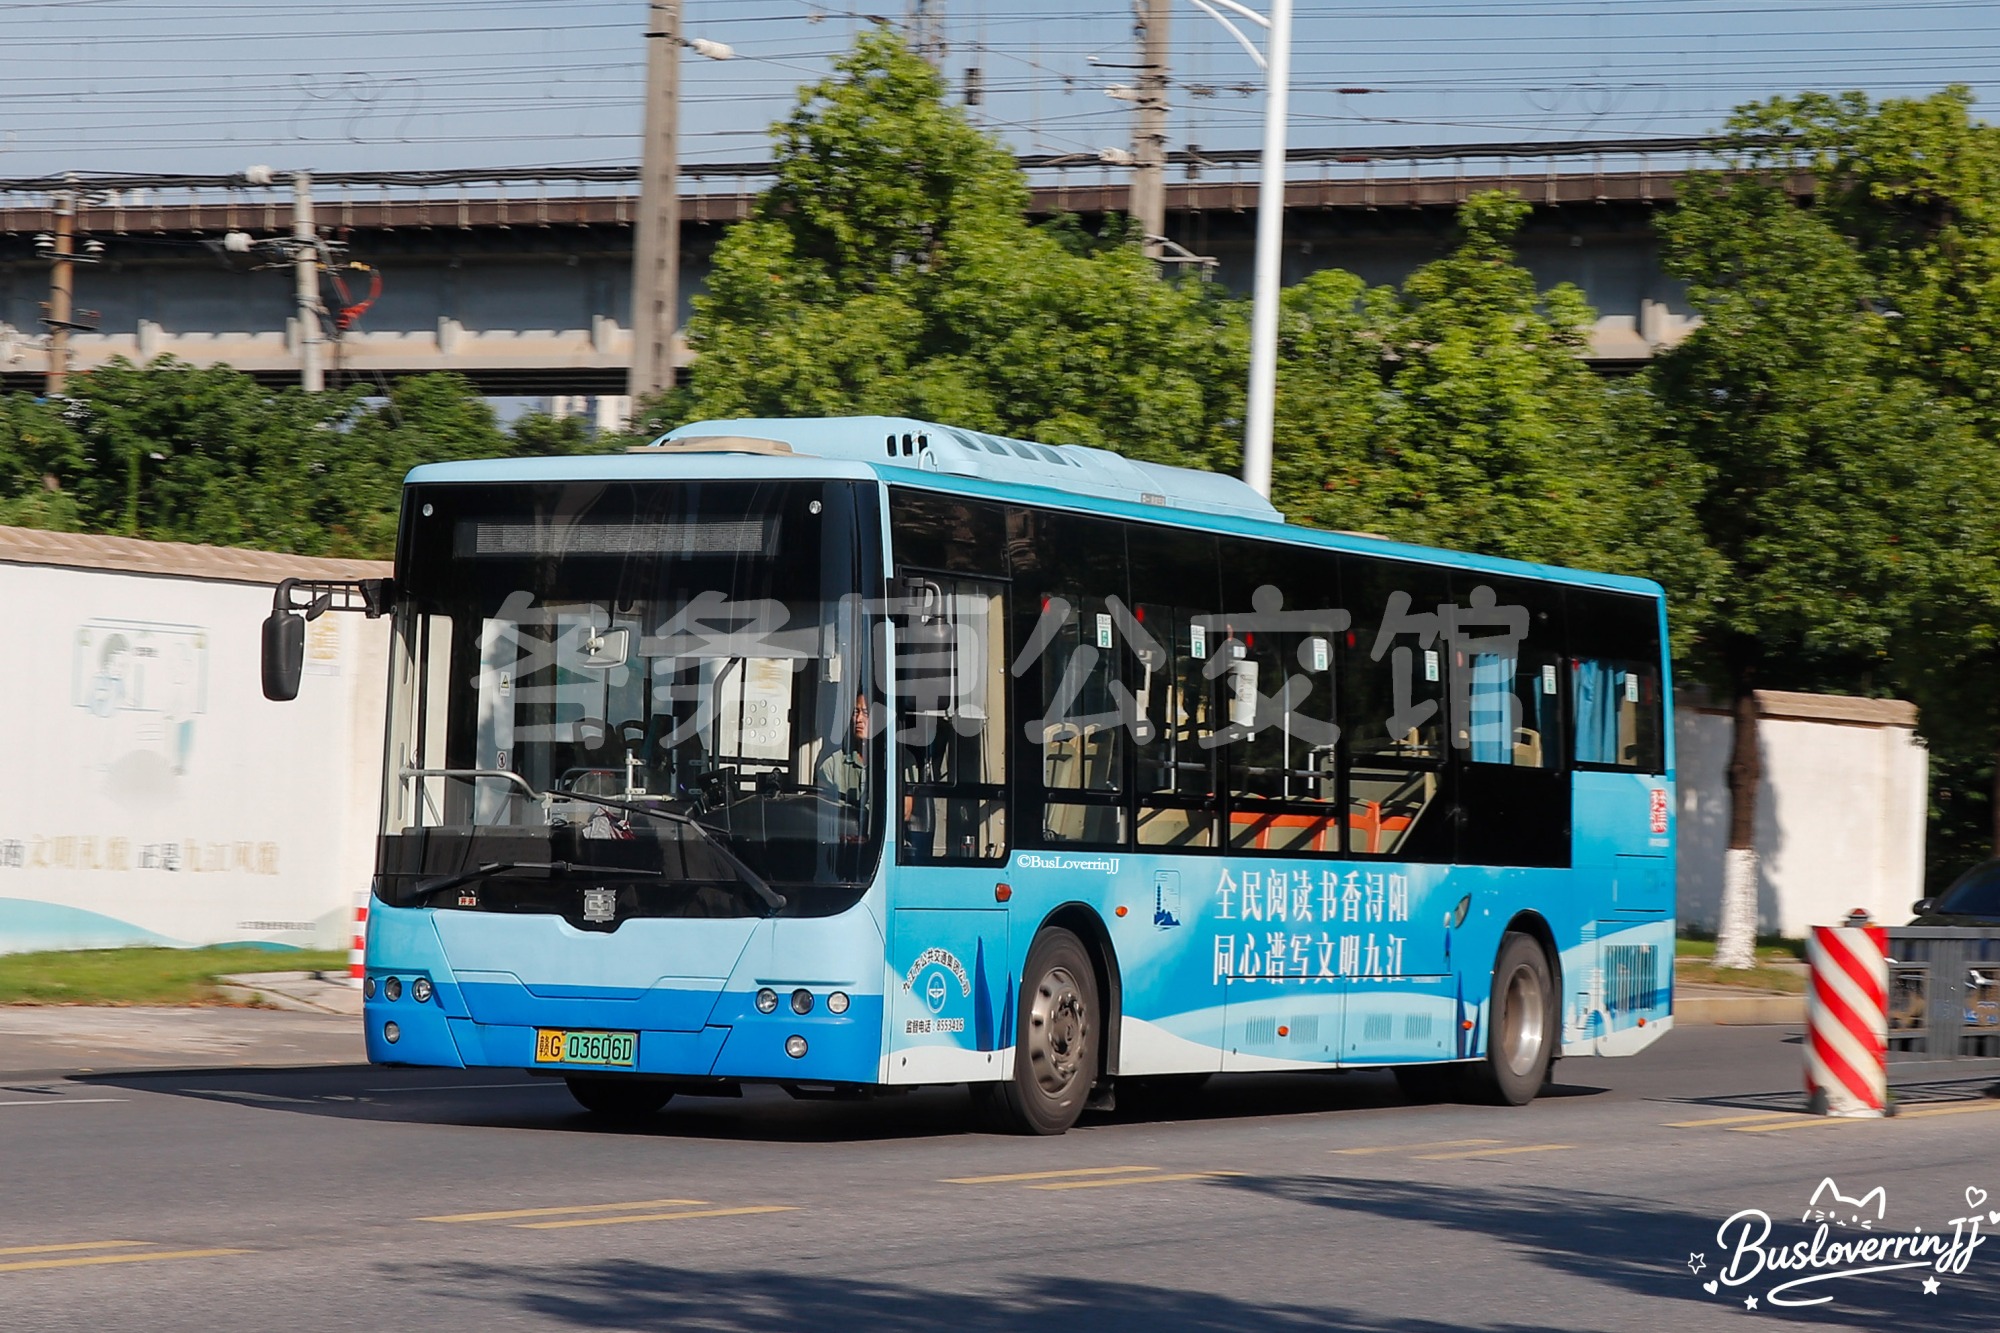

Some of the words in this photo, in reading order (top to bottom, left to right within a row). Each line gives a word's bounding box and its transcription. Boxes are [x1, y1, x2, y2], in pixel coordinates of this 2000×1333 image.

[1213, 867, 1409, 923] 全民阅读书香浔阳
[1212, 931, 1408, 986] 同心谱写文明九江
